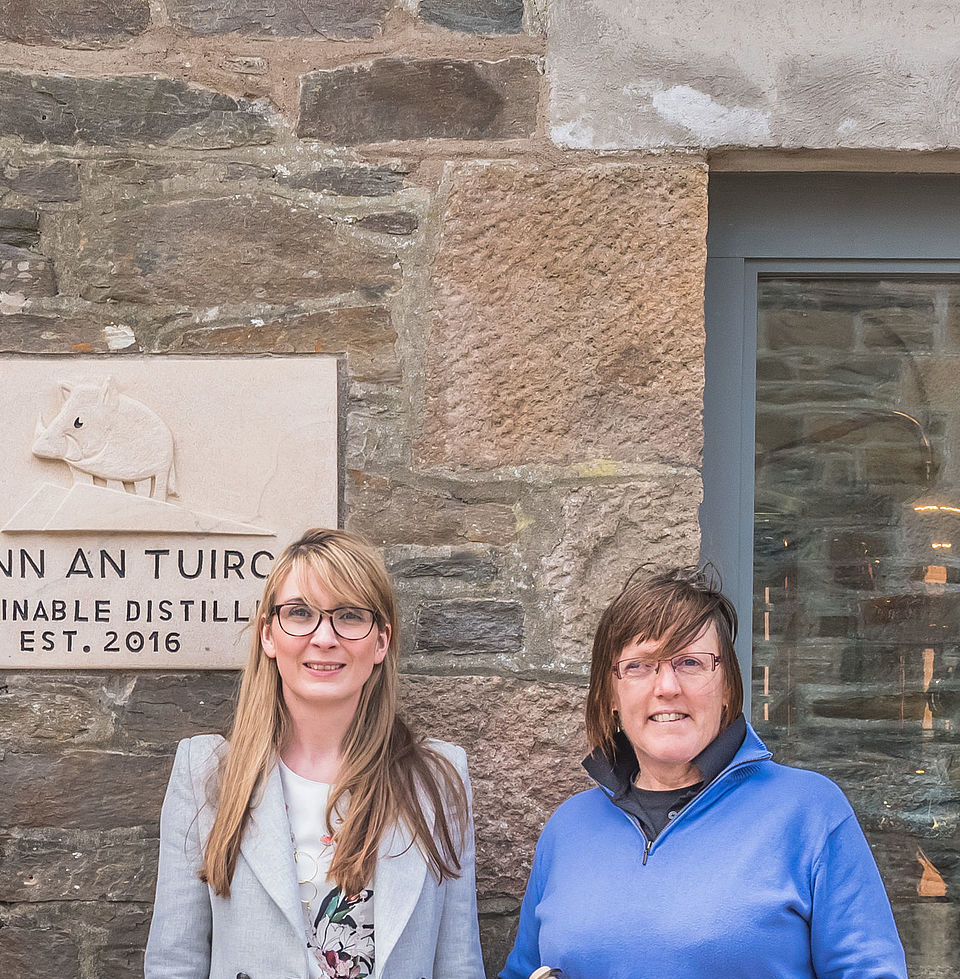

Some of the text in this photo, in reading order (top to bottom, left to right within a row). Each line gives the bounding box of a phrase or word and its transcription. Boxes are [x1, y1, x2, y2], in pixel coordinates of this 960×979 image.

[66, 548, 126, 579] AN
[145, 549, 275, 580] TUIRC
[126, 600, 260, 622] DISTILL
[20, 631, 182, 653] EST. 2016
